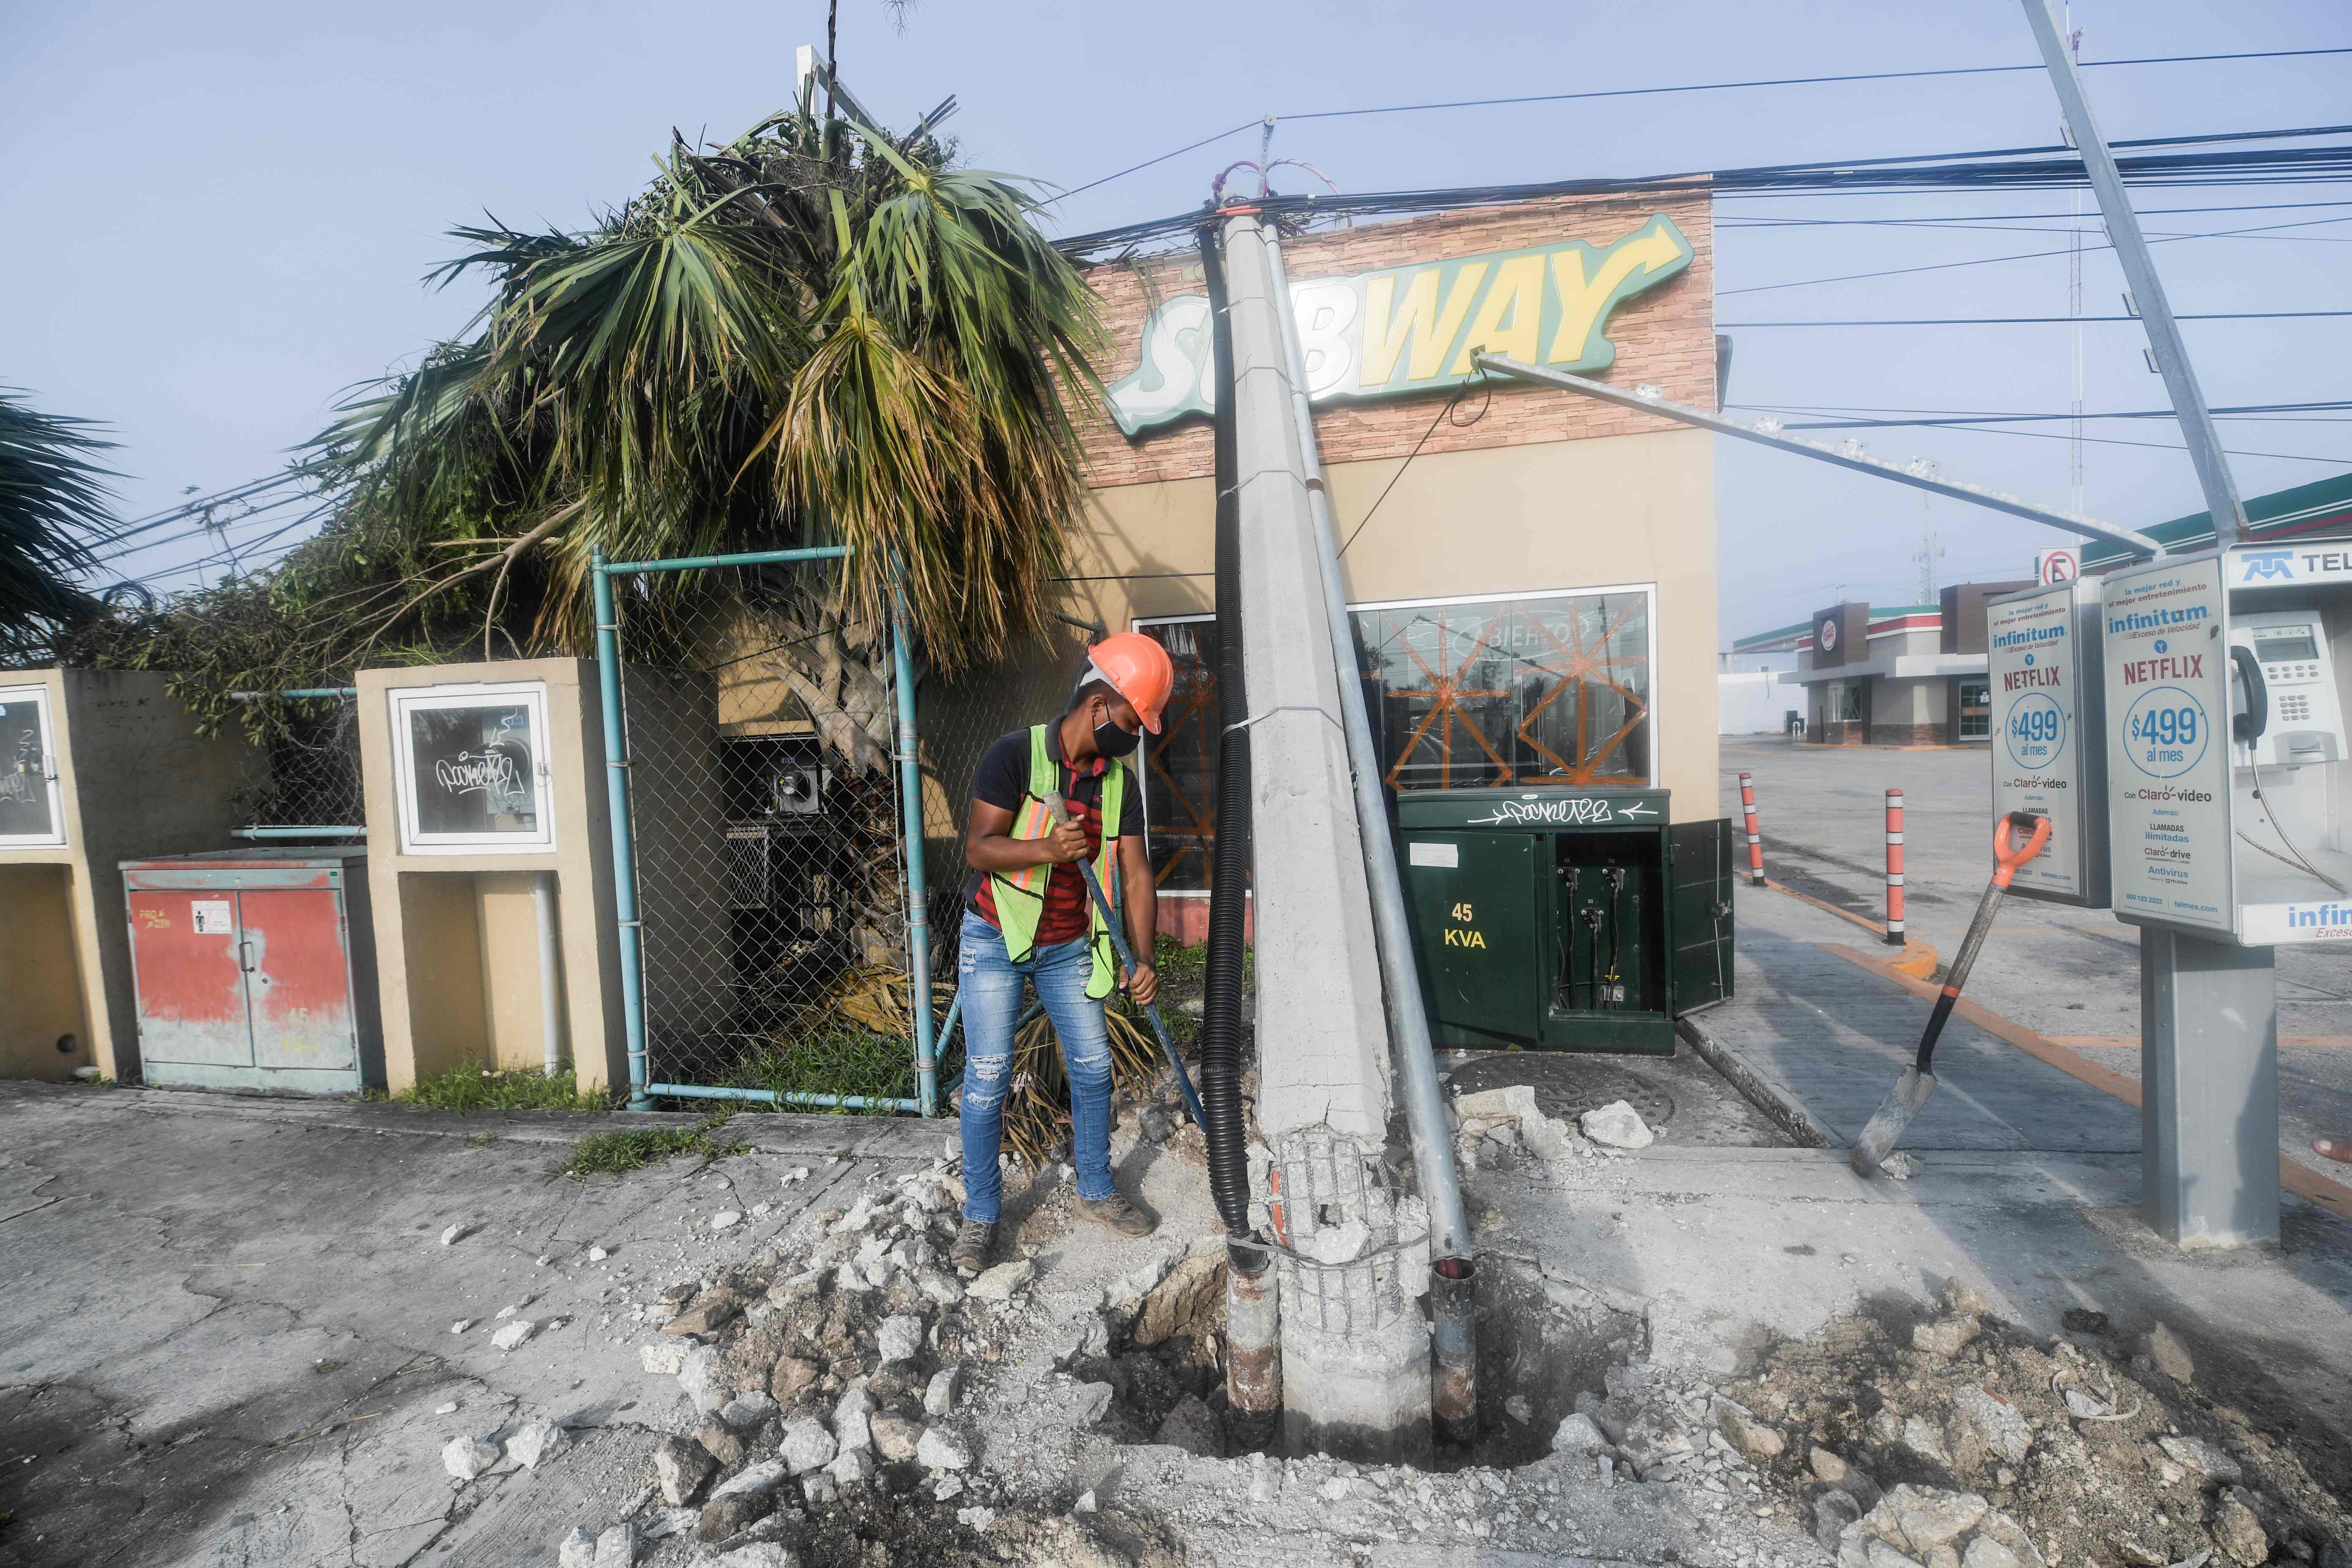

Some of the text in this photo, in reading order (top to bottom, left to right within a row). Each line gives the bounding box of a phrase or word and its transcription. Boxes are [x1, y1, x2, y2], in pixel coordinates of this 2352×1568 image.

[1111, 224, 1682, 426] SBWAY
[2115, 598, 2135, 607] mejor
[2138, 583, 2206, 602] entretenimiento
[2134, 585, 2156, 594] mejor
[2159, 580, 2173, 588] red
[2018, 607, 2066, 621] entretenimiento
[2109, 605, 2207, 633] infinitum
[1994, 626, 2064, 648] infinitum
[2133, 629, 2156, 638] Exceso
[2167, 622, 2200, 633] Velocidad
[2035, 639, 2058, 649] Velocidad
[2123, 654, 2203, 685] NETFLIX
[2004, 666, 2061, 692] NETFLIX
[2012, 710, 2057, 741] $499
[2132, 708, 2196, 745] $499
[2022, 744, 2047, 755] al mes
[2147, 747, 2183, 762] al mes
[2150, 823, 2184, 832] LLAMADAS
[2145, 832, 2190, 843] ilimitadas
[2041, 871, 2071, 881] telmex.com
[2148, 866, 2189, 878] Antivirus
[1452, 903, 1473, 922] 45
[2175, 900, 2218, 913] telmex.com
[1445, 929, 1486, 949] KVA
